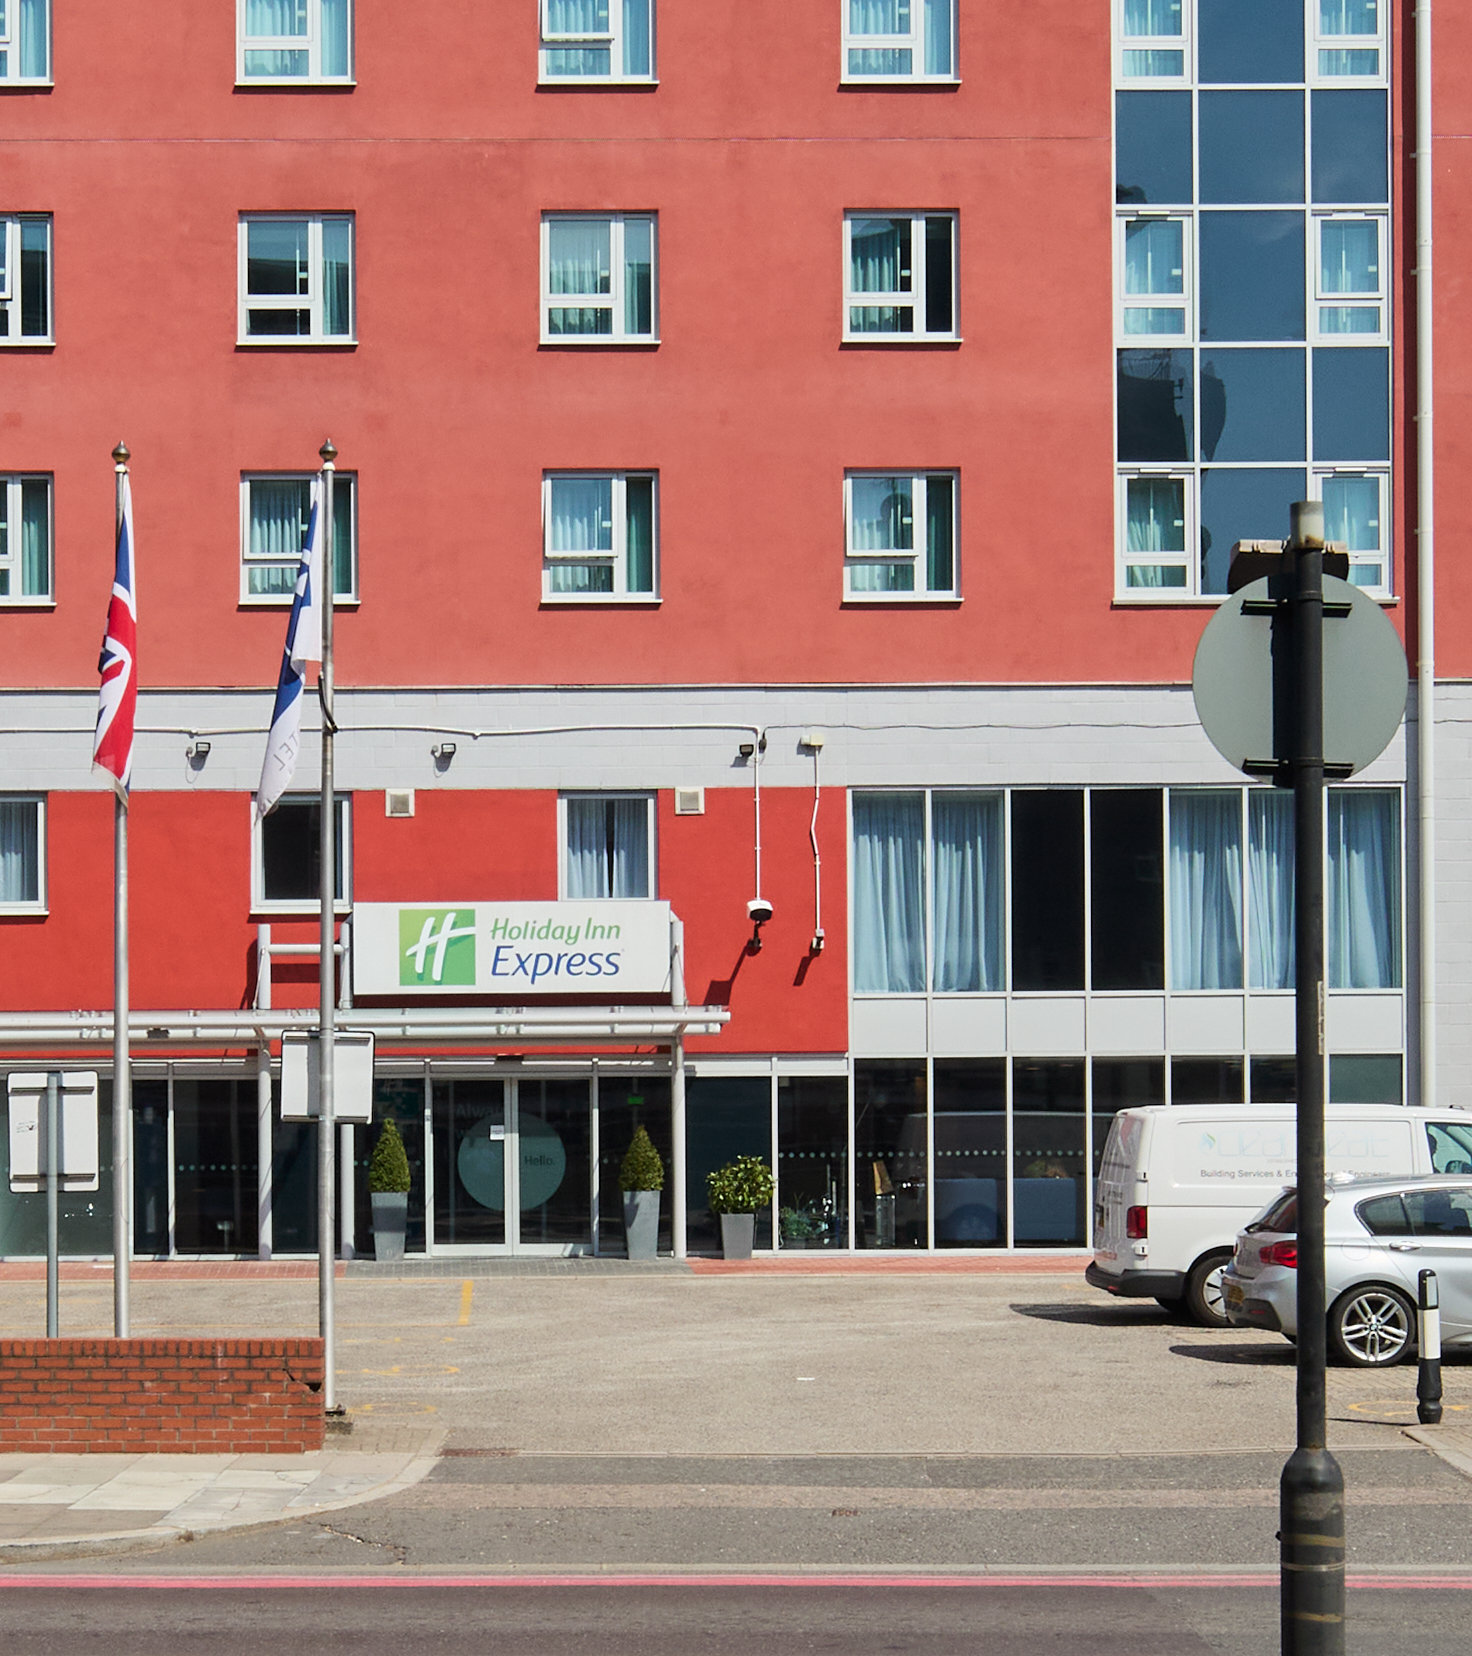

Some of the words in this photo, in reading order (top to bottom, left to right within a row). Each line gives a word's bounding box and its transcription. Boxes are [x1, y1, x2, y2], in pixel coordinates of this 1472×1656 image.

[489, 917, 581, 946] Holiday
[584, 917, 621, 940] Inn
[492, 946, 621, 984] Express
[1200, 1168, 1235, 1179] Building
[1238, 1169, 1273, 1178] Services
[1276, 1169, 1283, 1177] &
